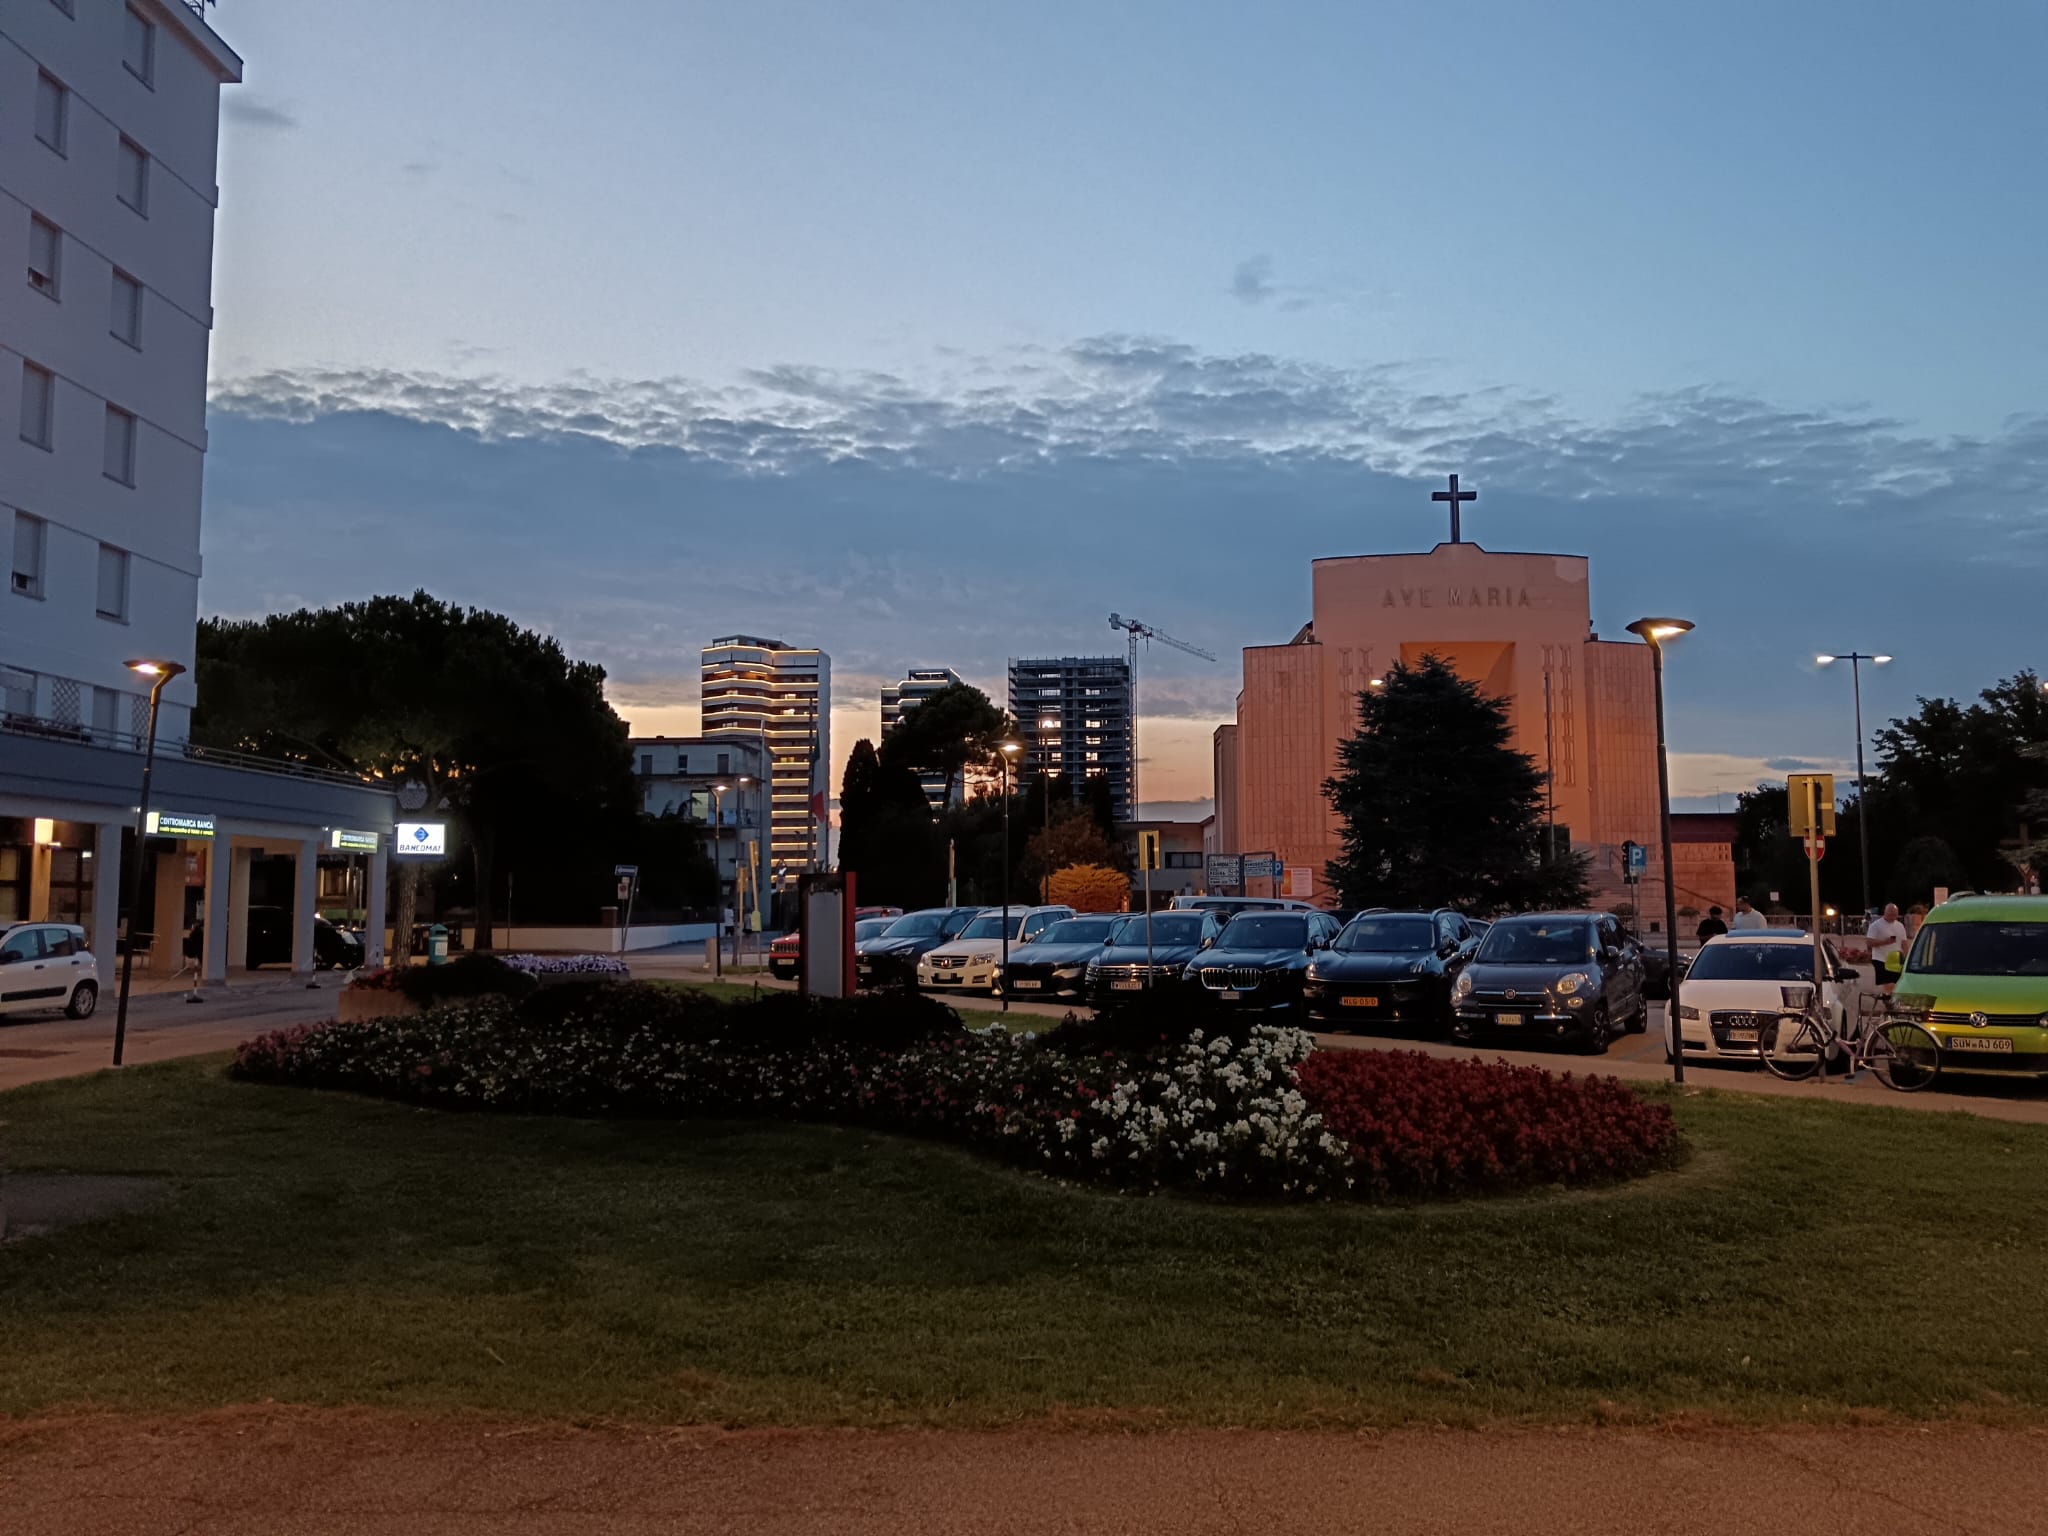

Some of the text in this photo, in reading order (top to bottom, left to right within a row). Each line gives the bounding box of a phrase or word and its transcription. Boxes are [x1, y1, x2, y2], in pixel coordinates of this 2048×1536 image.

[1382, 586, 1531, 608] AVE MARIA
[1632, 848, 1643, 865] P
[1274, 862, 1282, 875] P
